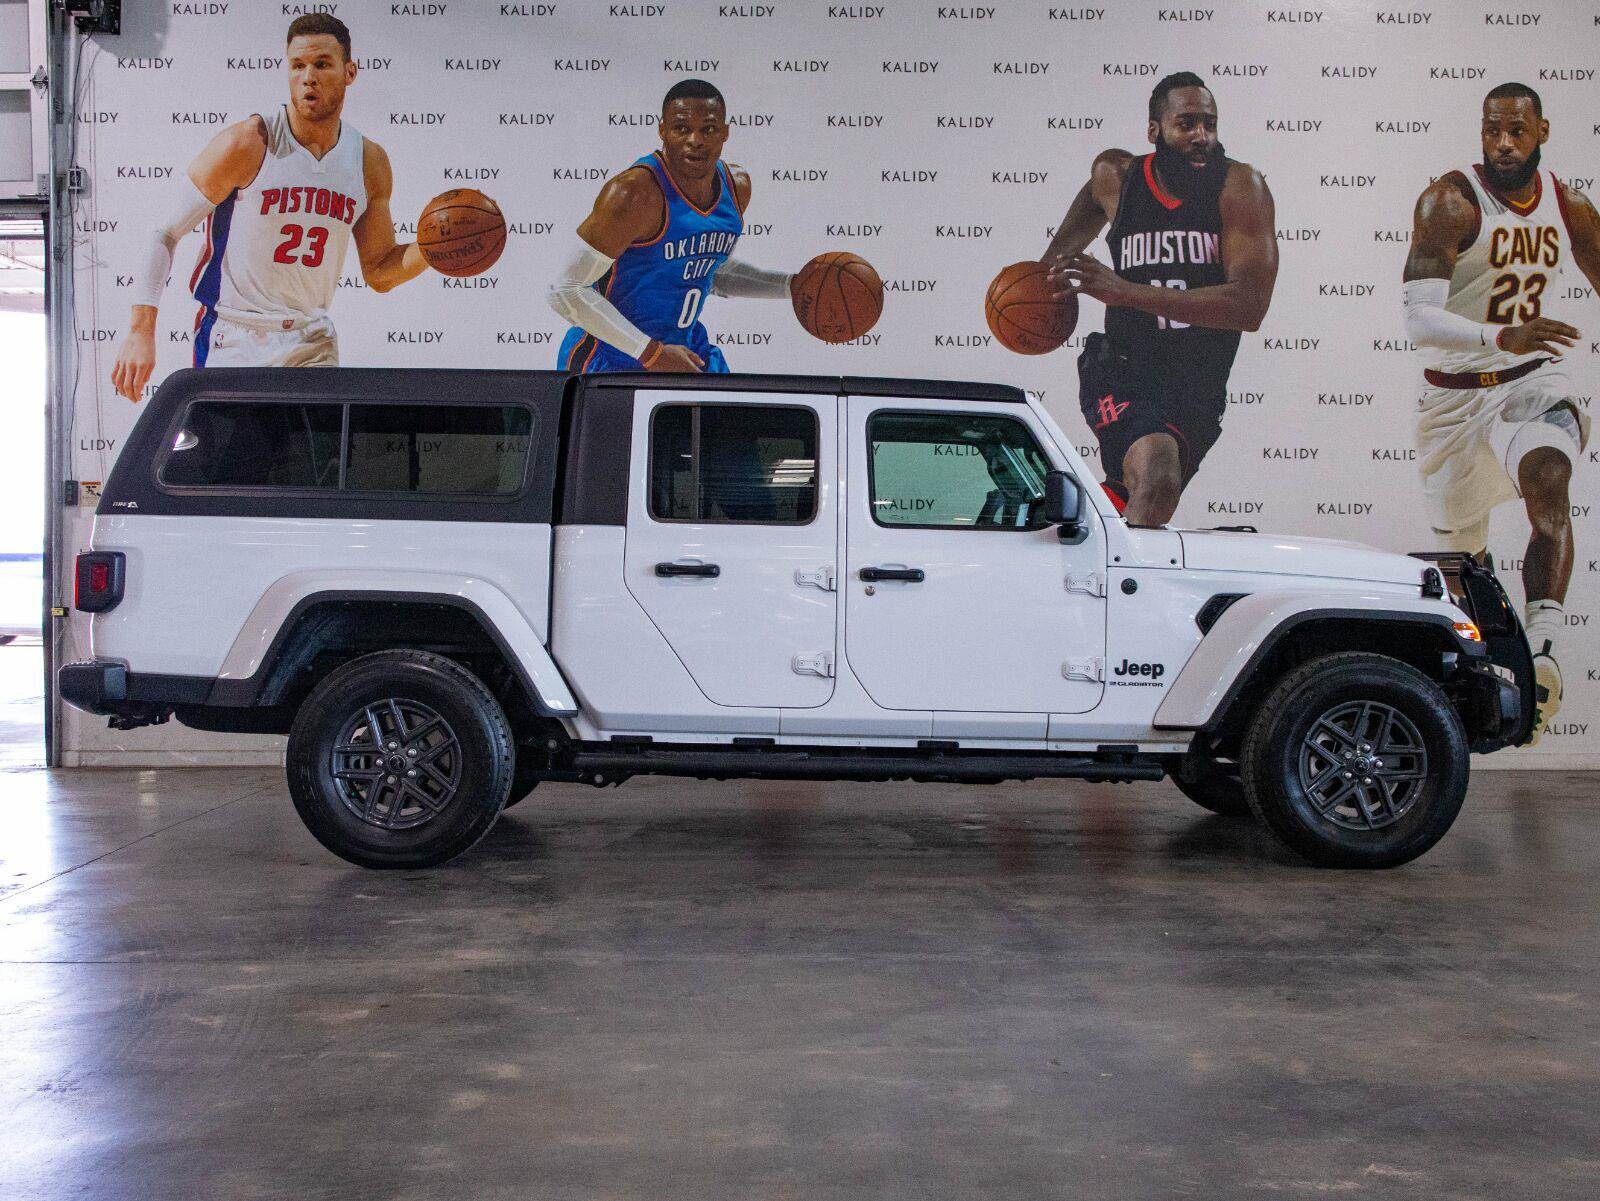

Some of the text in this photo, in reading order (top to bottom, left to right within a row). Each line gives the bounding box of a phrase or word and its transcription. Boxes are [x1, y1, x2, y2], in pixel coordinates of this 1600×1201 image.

[173, 2, 229, 15] KALIDY
[282, 3, 339, 15] KALIDY
[391, 3, 447, 16] KALIDY
[500, 4, 557, 16] KALIDY
[609, 4, 666, 17] KALIDY
[719, 5, 775, 18] KALIDY
[828, 5, 885, 18] KALIDY
[937, 7, 996, 20] KALIDY
[1048, 8, 1105, 21] KALIDY
[1158, 9, 1214, 22] KALIDY
[1267, 10, 1324, 23] KALIDY
[1376, 12, 1432, 25] KALIDY
[1485, 13, 1542, 26] KALIDY
[117, 57, 174, 70] KALIDY
[227, 57, 283, 70] KALIDY
[357, 58, 392, 70] LIDY
[445, 58, 502, 71] KALIDY
[554, 59, 611, 71] KALIDY
[663, 59, 720, 72] KALIDY
[773, 60, 830, 73] KALIDY
[882, 60, 939, 73] KALIDY
[993, 61, 1050, 75] KALIDY
[1103, 62, 1159, 76] KALIDY
[1212, 64, 1269, 77] KALIDY
[1321, 65, 1378, 78] KALIDY
[1430, 67, 1486, 80] KALIDY
[1539, 68, 1595, 81] KALIDY
[172, 112, 228, 124] KALIDY
[390, 112, 446, 125] KALIDY
[499, 113, 555, 125] KALIDY
[729, 115, 774, 127] ALIDY
[827, 115, 884, 128] KALIDY
[937, 116, 994, 129] KALIDY
[1047, 117, 1104, 130] KALIDY
[1266, 119, 1323, 132] KALIDY
[1375, 121, 1431, 133] KALIDY
[117, 166, 174, 179] KALIDY
[443, 167, 500, 180] KALIDY
[553, 168, 610, 180] KALIDY
[772, 169, 828, 182] KALIDY
[881, 170, 938, 183] KALIDY
[992, 171, 1049, 184] KALIDY
[1320, 175, 1376, 187] KALIDY
[260, 186, 357, 225] PISTONS
[508, 223, 554, 235] ALIDY
[826, 224, 883, 237] KALIDY
[935, 225, 993, 238] KALIDY
[1276, 229, 1321, 241] ALIDY
[1374, 230, 1414, 242] KALI
[273, 223, 329, 268] 23
[664, 232, 738, 260] OKLAHOM
[1120, 230, 1220, 271] HOUSTON
[1489, 226, 1560, 269] CAVS
[683, 258, 716, 280] CITY
[442, 277, 499, 289] KALIDY
[1319, 284, 1375, 297] KALIDY
[1486, 272, 1548, 325] 23
[677, 288, 702, 329] 0
[80, 330, 117, 342] LIDY
[387, 331, 444, 344] KALIDY
[496, 331, 553, 344] KALIDY
[715, 333, 772, 346] KALIDY
[934, 334, 991, 347] KALIDY
[1263, 338, 1320, 351] KALIDY
[1480, 371, 1499, 386] CLE
[1318, 393, 1374, 406] KALIDY
[80, 439, 116, 451] LIDY
[495, 441, 525, 453] KAL
[933, 444, 980, 457] KALID
[1263, 447, 1319, 460] KALIDY
[1207, 501, 1264, 514] KALIDY
[1317, 502, 1373, 515] KALIDY
[1563, 614, 1590, 626] IDY
[1114, 659, 1165, 680] Jeep
[1543, 723, 1588, 736] ALIDY
